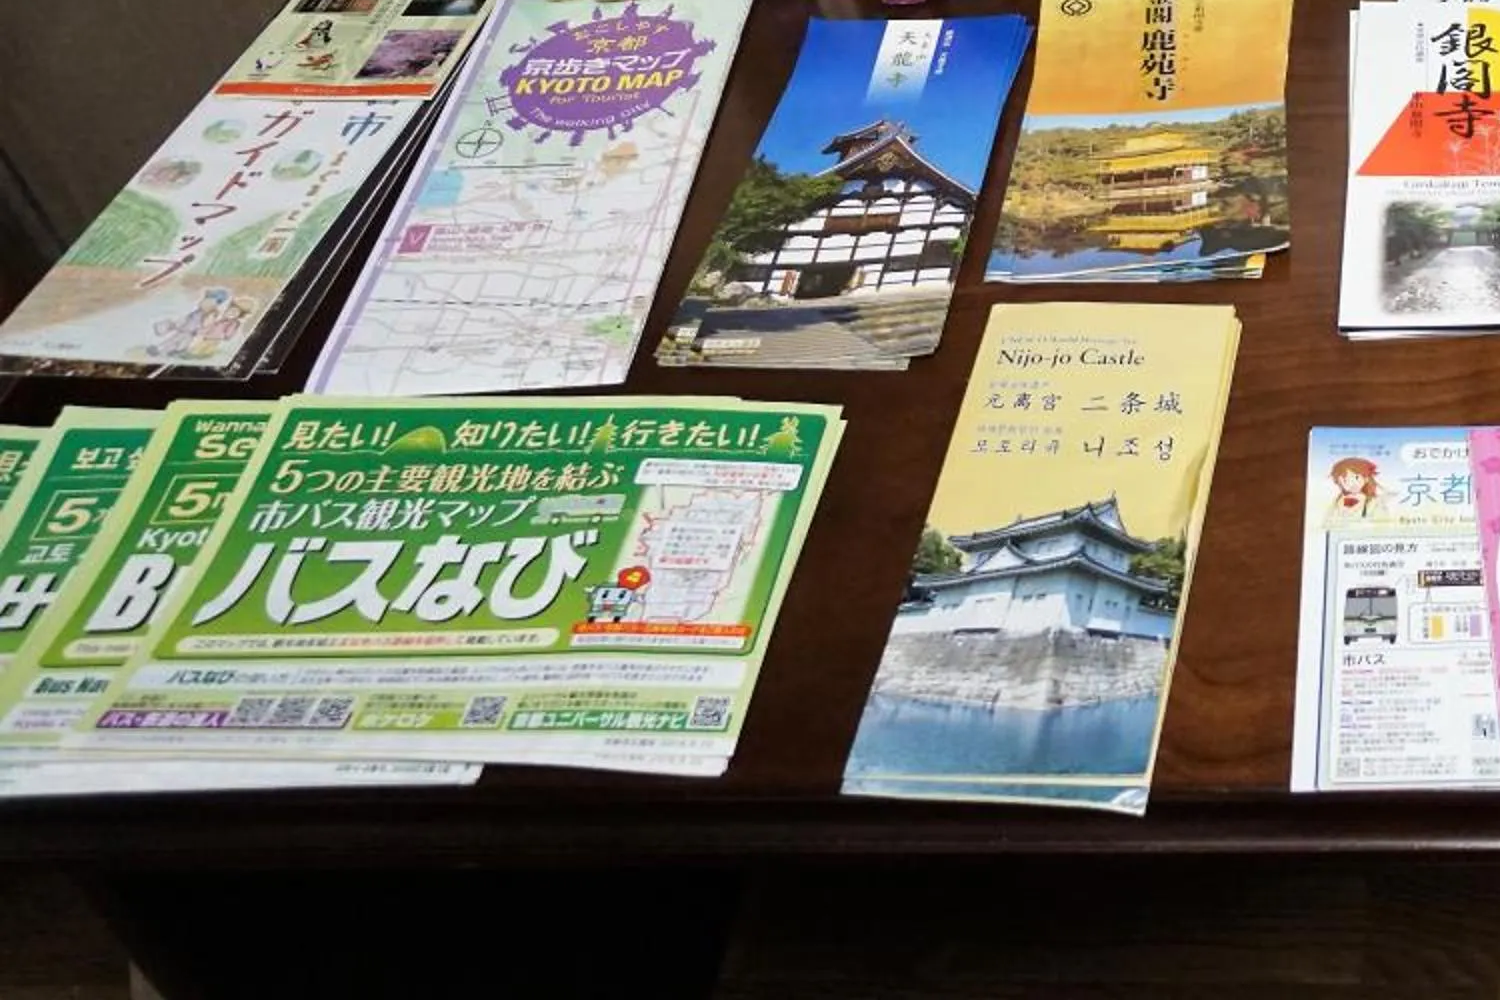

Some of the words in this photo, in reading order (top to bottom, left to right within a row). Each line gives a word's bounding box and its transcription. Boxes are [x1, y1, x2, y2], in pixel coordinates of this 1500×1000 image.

[515, 75, 611, 96] KYOTO
[618, 69, 685, 91] MAP
[1430, 22, 1499, 139] 銀閣寺
[997, 348, 1072, 368] Nijo-jo
[1080, 347, 1145, 366] Castle
[270, 459, 626, 496] 5つの主要観光地を結ぶ
[248, 495, 538, 535] 市バス観光マップ
[191, 529, 600, 628] バスなび
[1342, 652, 1386, 667] 市バス
